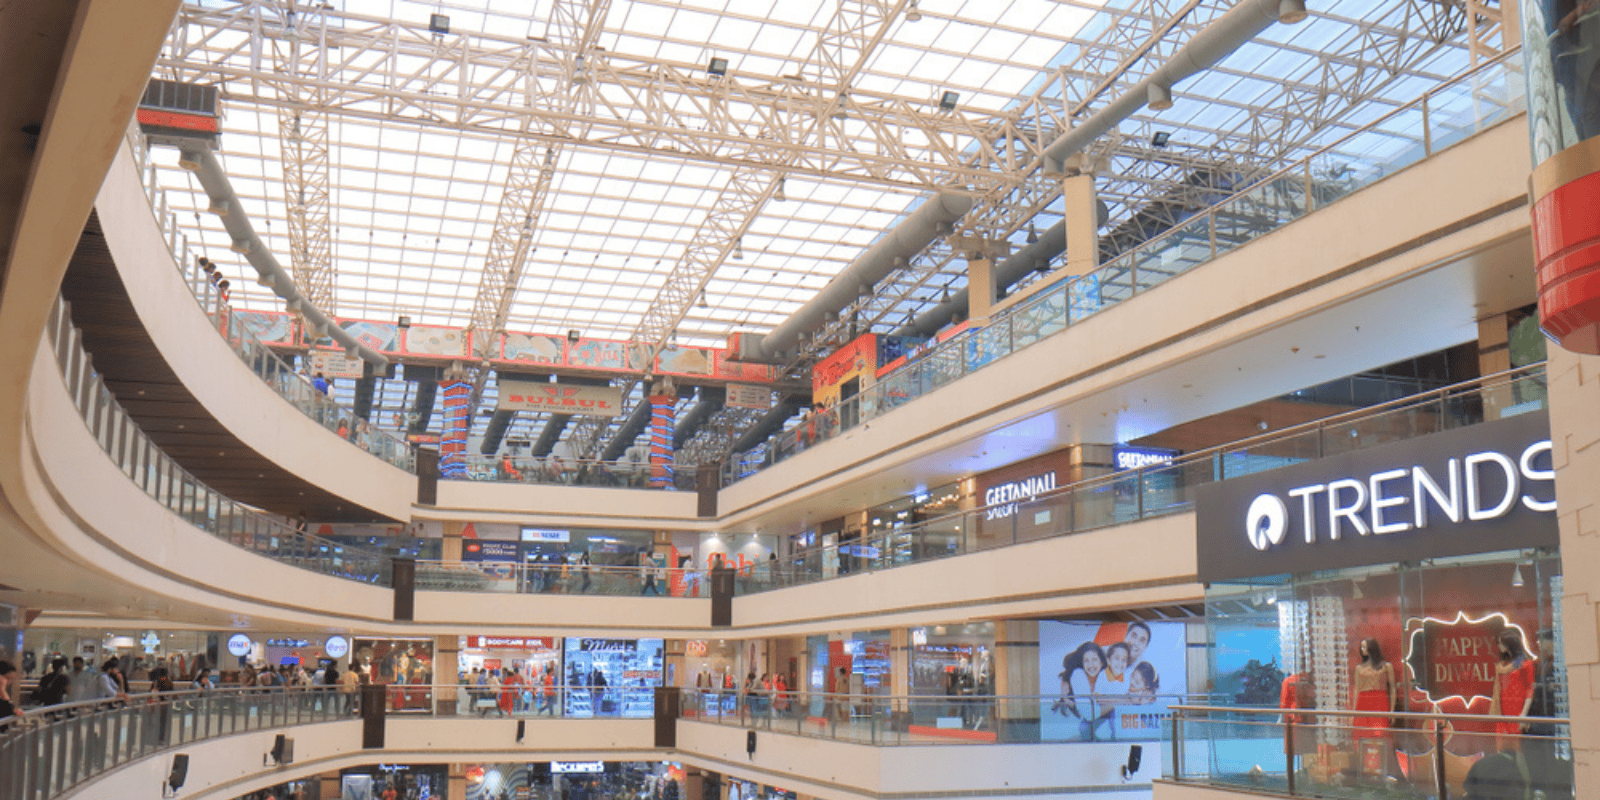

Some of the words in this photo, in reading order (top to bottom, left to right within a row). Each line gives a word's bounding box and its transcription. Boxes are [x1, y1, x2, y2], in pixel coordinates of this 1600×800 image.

[509, 394, 611, 409] BULBUL
[985, 471, 1057, 507] GEETANJALI
[1288, 440, 1558, 544] TRENDS
[1435, 636, 1496, 657] HAPPY
[1435, 663, 1496, 682] DIWAL
[1121, 714, 1138, 730] BIG
